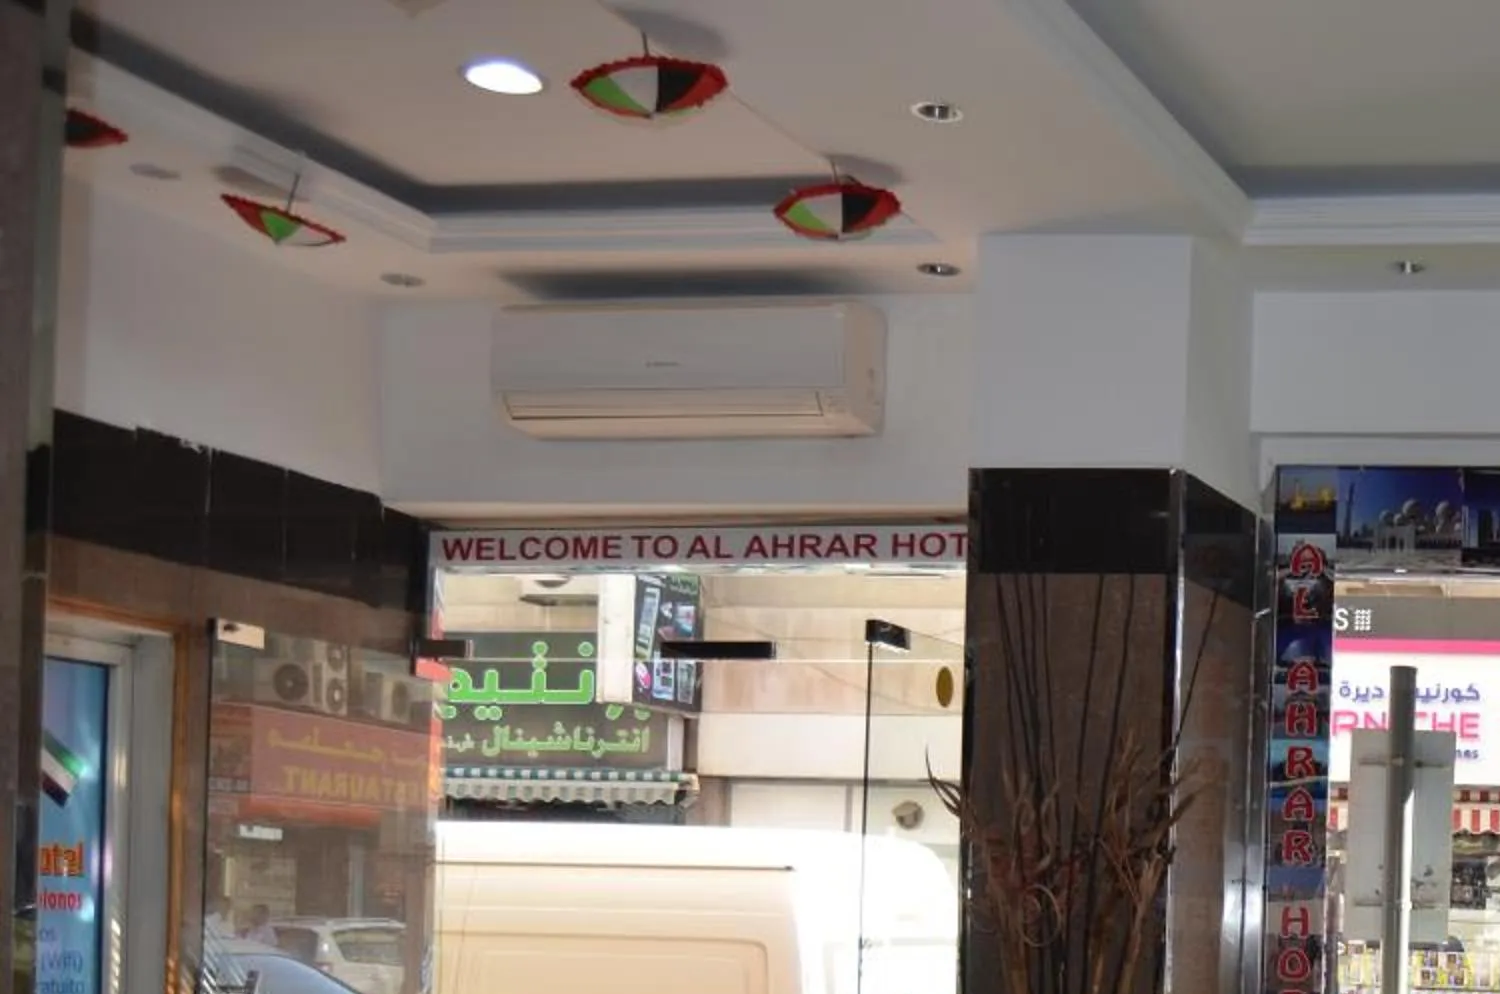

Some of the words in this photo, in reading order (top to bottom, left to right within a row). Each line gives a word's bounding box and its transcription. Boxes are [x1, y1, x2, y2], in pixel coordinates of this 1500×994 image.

[443, 535, 622, 561] WELCOME
[632, 534, 679, 559] TO
[686, 533, 733, 559] AL
[743, 532, 878, 558] AHRAR
[892, 531, 967, 557] HOT
